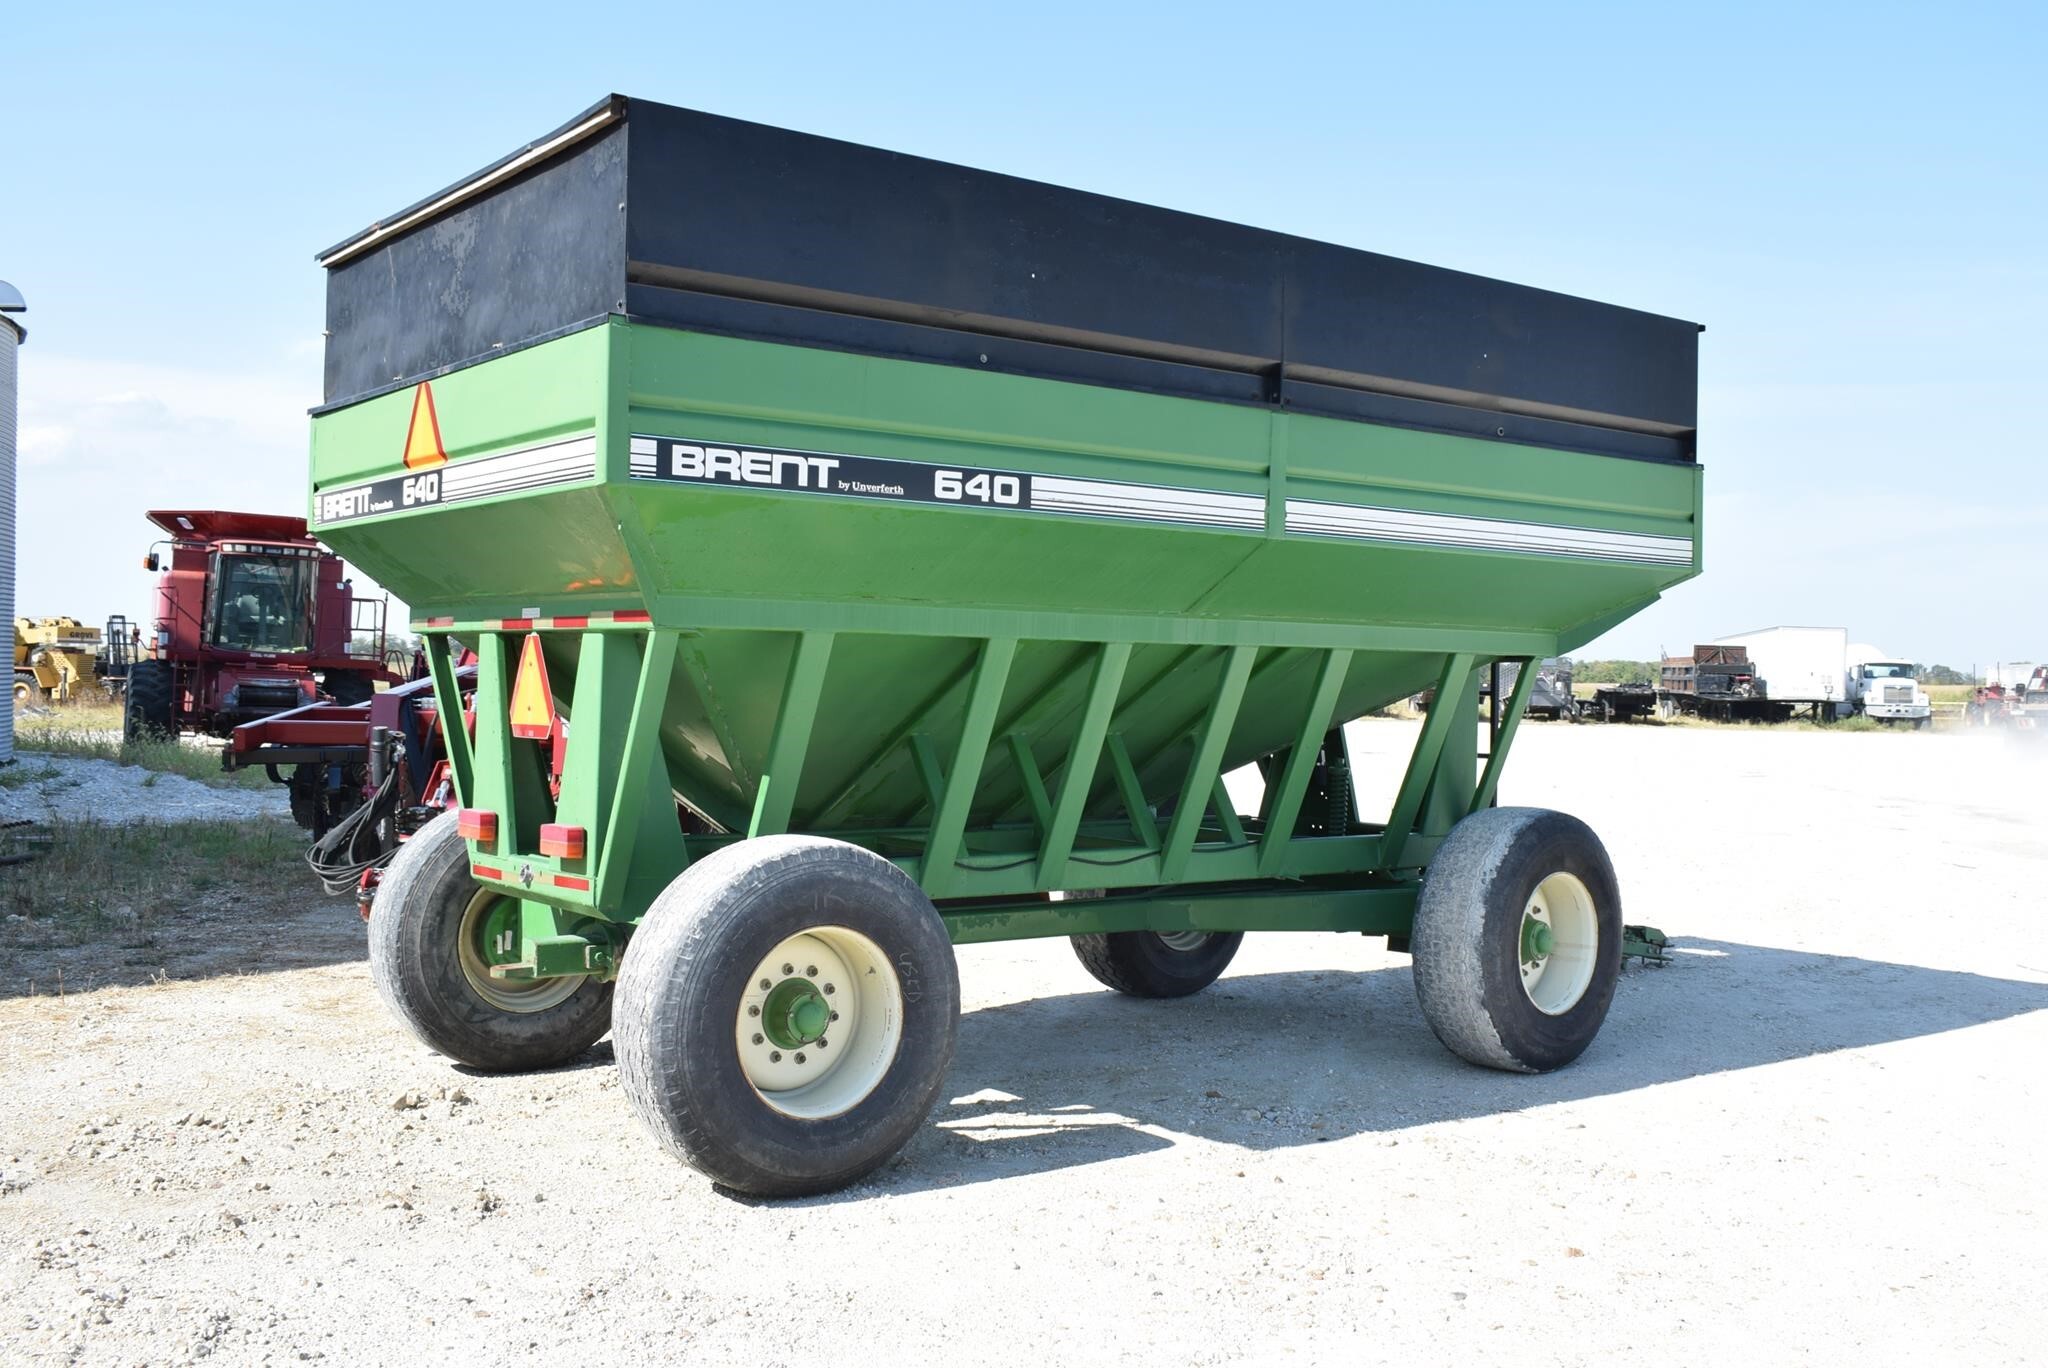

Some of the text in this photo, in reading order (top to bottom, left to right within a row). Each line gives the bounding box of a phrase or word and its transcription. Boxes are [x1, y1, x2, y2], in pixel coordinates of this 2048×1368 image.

[323, 473, 439, 521] BRENT 640
[672, 444, 1020, 505] BRENT by Unverferth 640
